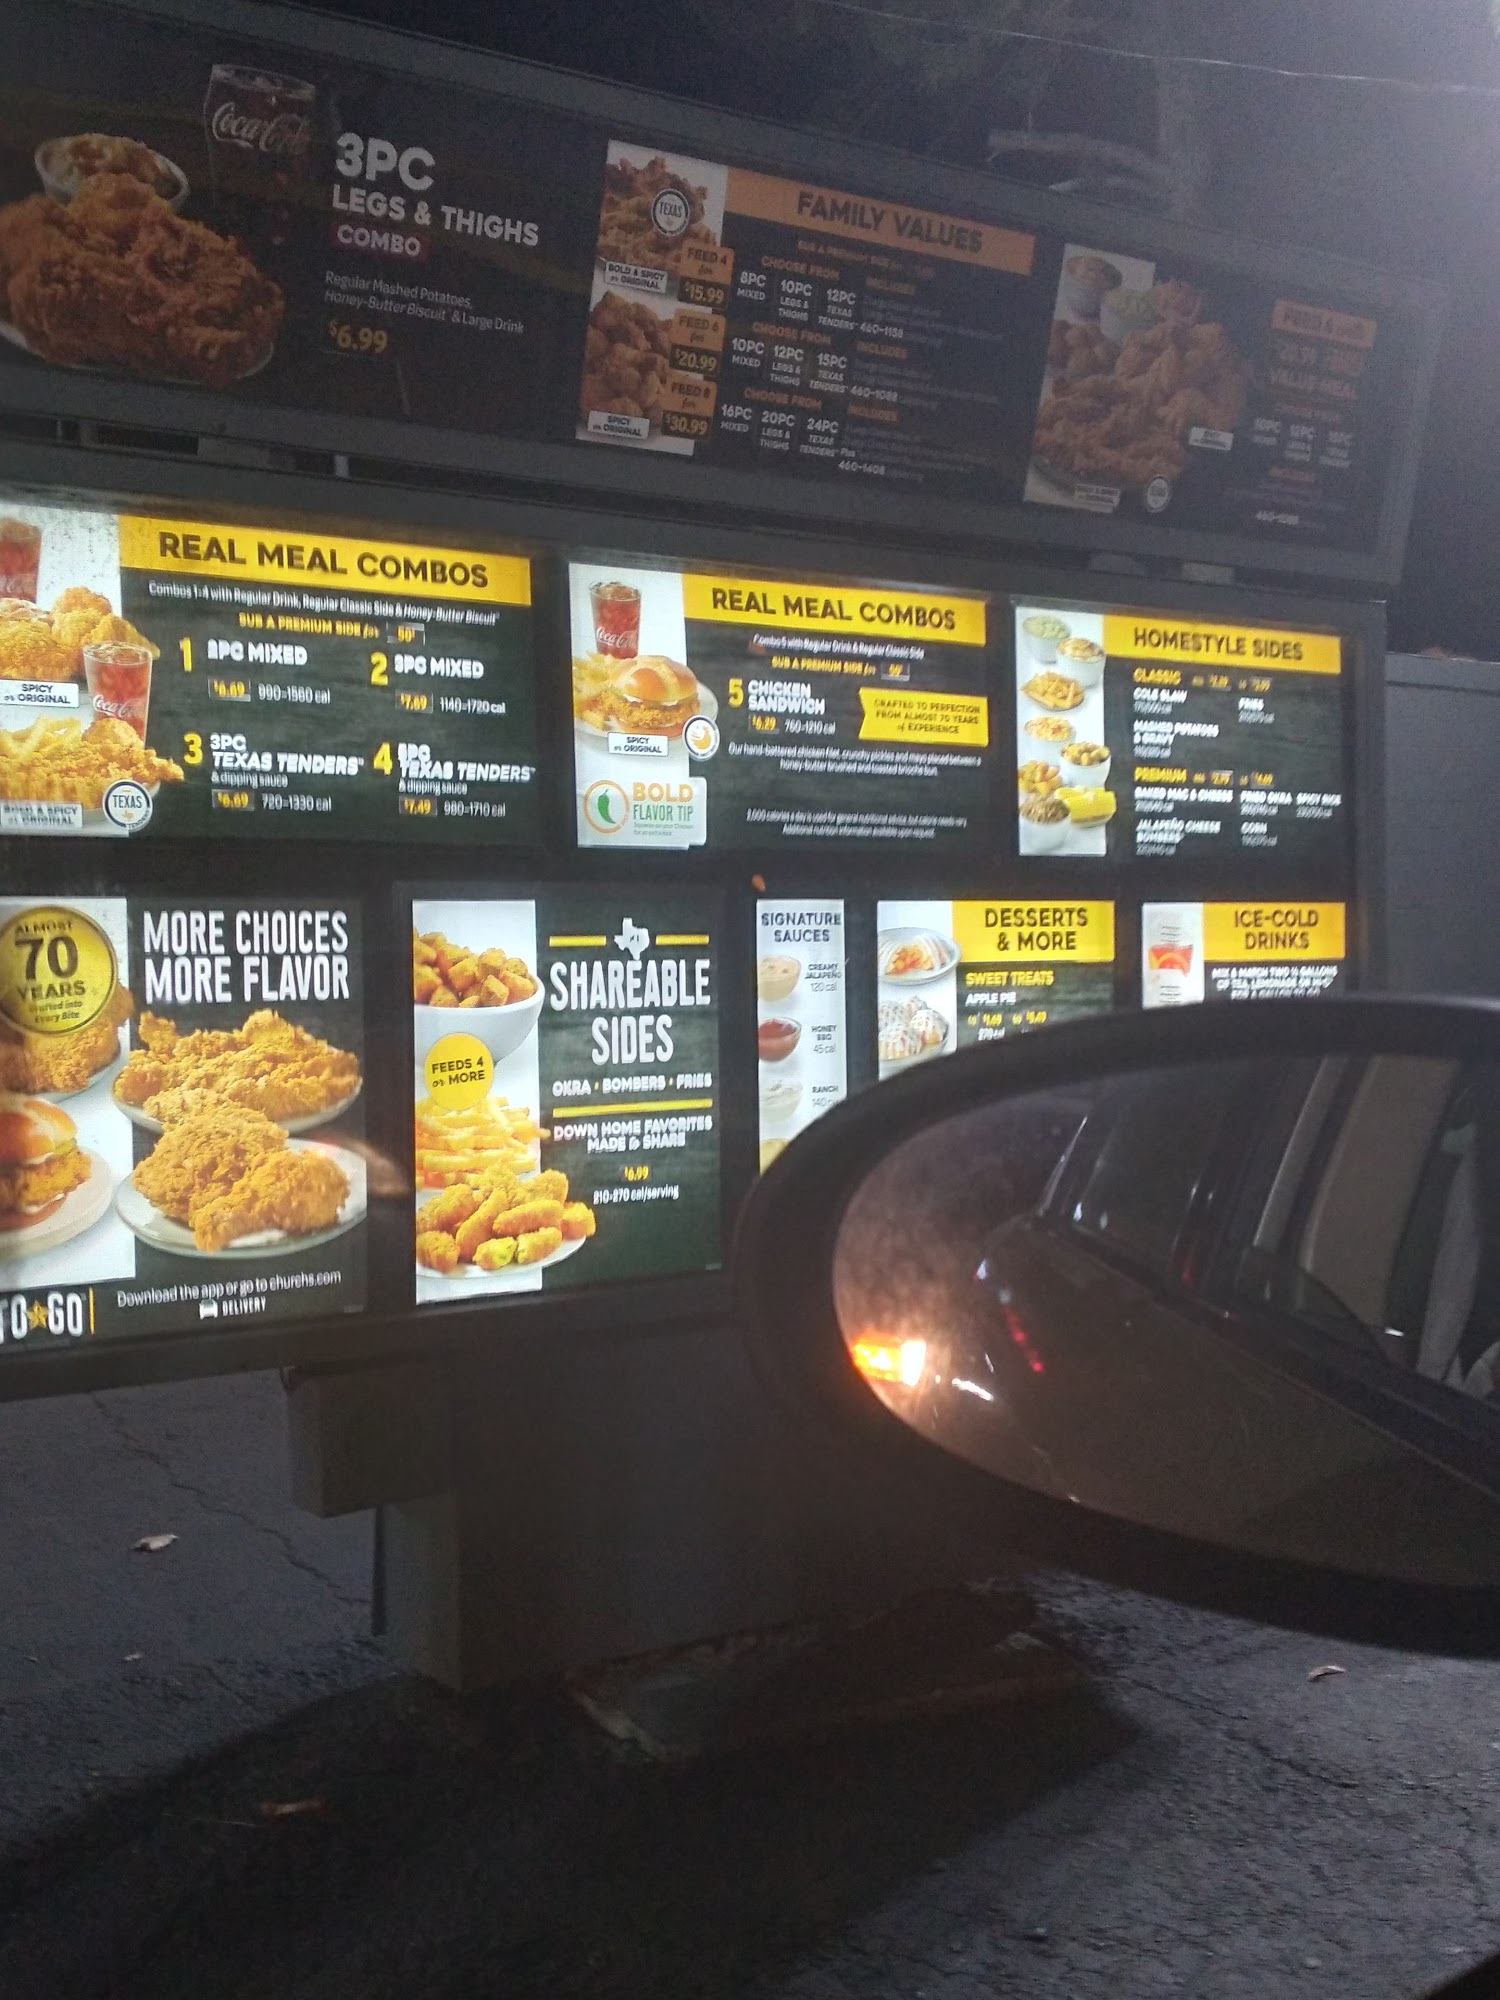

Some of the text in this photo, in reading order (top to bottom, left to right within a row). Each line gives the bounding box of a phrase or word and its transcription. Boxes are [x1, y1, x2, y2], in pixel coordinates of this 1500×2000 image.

[336, 132, 436, 190] 3PC
[332, 184, 539, 247] LEGS & THIGHS
[660, 201, 684, 218] TEXAS
[797, 191, 984, 253] FAMILY VALUES
[337, 224, 421, 256] COMBO
[687, 247, 718, 262] FEED
[608, 263, 631, 275] BOLD
[326, 271, 371, 290] Regular
[372, 279, 418, 299] Mashed
[620, 275, 661, 290] ORIGINAL
[739, 271, 766, 287] 8PC
[781, 280, 812, 297] 10PC
[737, 288, 766, 301] MIXED
[827, 289, 856, 305] 12PC
[325, 289, 524, 334] Honey-Butter & Large Drink
[328, 320, 390, 353] $6.99
[732, 337, 765, 354] 10PC
[675, 348, 717, 372] $20.99
[732, 355, 761, 368] MIXED
[774, 345, 804, 361] 12PC
[722, 403, 752, 421] 16PC
[762, 410, 795, 427] 20PC
[720, 421, 749, 433] MIXED
[807, 417, 839, 434] 24PC
[159, 531, 489, 589] REAL MEAL COMBOS
[148, 580, 192, 600] Combos
[211, 587, 232, 602] with
[234, 588, 271, 606] Regular
[302, 594, 339, 611] Regular
[340, 597, 373, 614] Classic
[374, 600, 395, 616] Side
[404, 603, 464, 622] Honey-Butter
[712, 587, 956, 630] REAL MEAL COMBOS
[239, 611, 361, 637] SUB A PREMIUM SIDE
[248, 641, 308, 666] MIXED
[1133, 627, 1303, 661] HOMESTYLE SIDES
[179, 637, 192, 673] 1
[370, 651, 388, 687] 2
[430, 656, 485, 680] MIXED
[22, 684, 53, 694] SPICY
[728, 678, 744, 708] 5
[748, 679, 812, 700] CHICKEN
[18, 693, 71, 705] ORIGINAL
[490, 701, 506, 714] cal
[748, 695, 826, 715] SANDWICH
[908, 723, 959, 734] EXPERIENCE
[183, 731, 203, 765] 3
[210, 732, 247, 752] 3PC
[624, 744, 662, 754] ORIGINAL
[626, 736, 650, 745] SPICY
[212, 751, 272, 773] TEXAS
[373, 742, 393, 775] 4
[400, 760, 454, 780] TEXAS
[211, 771, 289, 789] & dipping sauce
[407, 779, 468, 797] dipping sauce
[112, 794, 143, 809] TEXAS
[633, 782, 694, 803] BOLD
[316, 796, 332, 811] cal
[491, 803, 506, 817] cal
[633, 804, 694, 821] FLAVOR TIP
[761, 912, 842, 927] SIGNATURE
[985, 907, 1089, 928] DESSERTS
[1234, 909, 1319, 928] ICE-COLD
[143, 910, 348, 955] MORE CHOICES
[774, 928, 830, 943] SAUCES
[997, 930, 1077, 951] & MORE
[1245, 931, 1309, 950] DRINKS
[15, 936, 78, 981] 70
[808, 963, 839, 972] CREAMY
[145, 954, 350, 1005] MORE FLAVOR
[805, 970, 842, 980] JALAPEÑO
[965, 969, 1055, 988] SWEET TREATS
[16, 980, 86, 1000] YEARS
[550, 959, 711, 1011] SHAREABLE
[811, 982, 838, 993] 120 cal
[65, 1000, 82, 1008] into
[61, 1011, 80, 1020] Bite
[811, 1024, 837, 1033] HONEY
[817, 1033, 832, 1042] BBQ
[591, 1014, 674, 1066] SIDES
[813, 1043, 836, 1054] 45 cal
[431, 1056, 483, 1075] FEEDS 4
[432, 1070, 485, 1088] or MORE
[552, 1072, 713, 1097] OKRA BOMBERS FRIES
[812, 1085, 839, 1095] RANCH
[554, 1115, 713, 1142] DOWN HOME FAVORITES
[587, 1132, 686, 1154] MADE SHARE
[631, 1184, 680, 1203] cal/serving
[117, 1271, 341, 1308] Download the app or go to churchs.com
[47, 1290, 83, 1337] GO
[222, 1295, 267, 1317] DELIVERY
